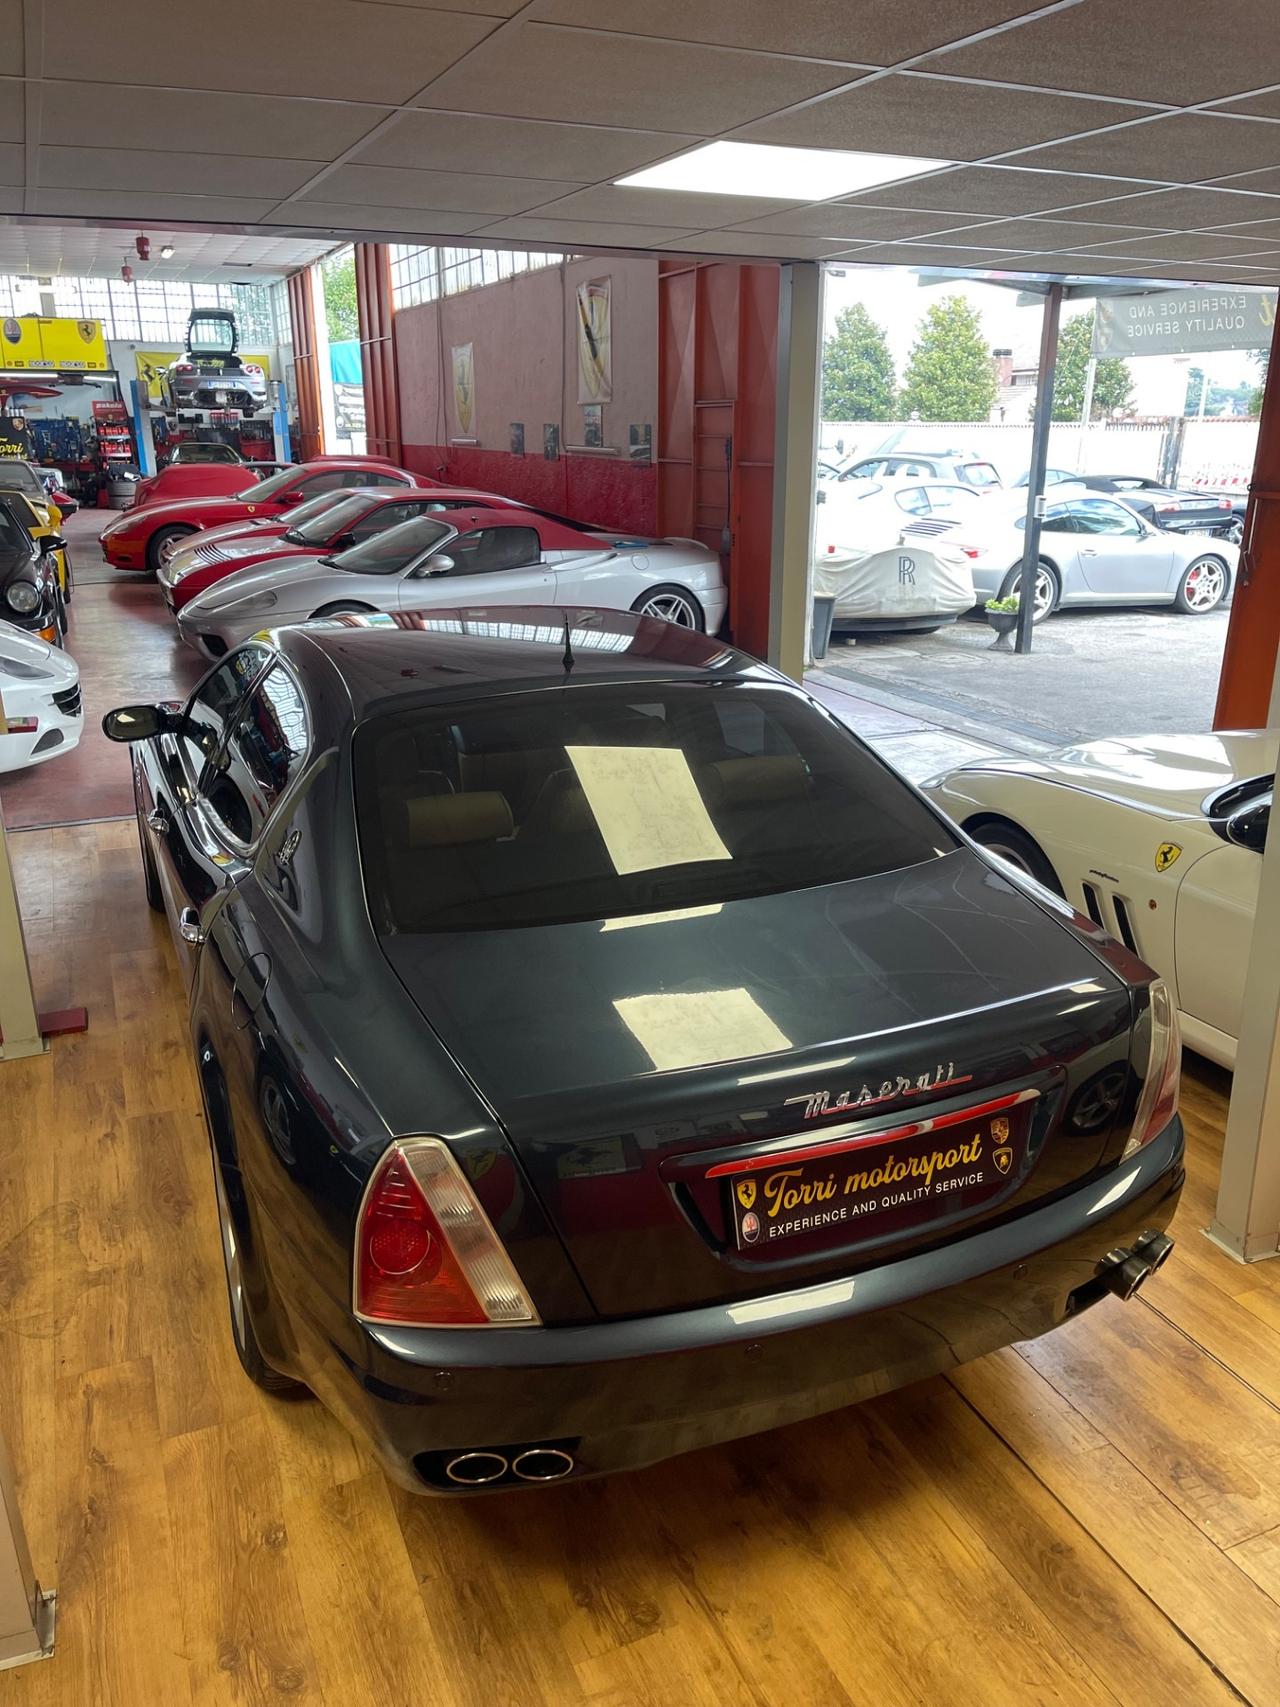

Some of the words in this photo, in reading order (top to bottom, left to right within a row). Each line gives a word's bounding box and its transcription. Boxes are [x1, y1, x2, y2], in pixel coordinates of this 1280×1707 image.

[783, 1062, 973, 1119] Maserati
[764, 1168, 837, 1218] Torri
[844, 1133, 983, 1193] motorsport
[769, 1207, 847, 1238] EXPERIENCE
[852, 1199, 877, 1216] AND
[881, 1185, 931, 1208] QUALITY
[935, 1172, 984, 1194] SERVICE
